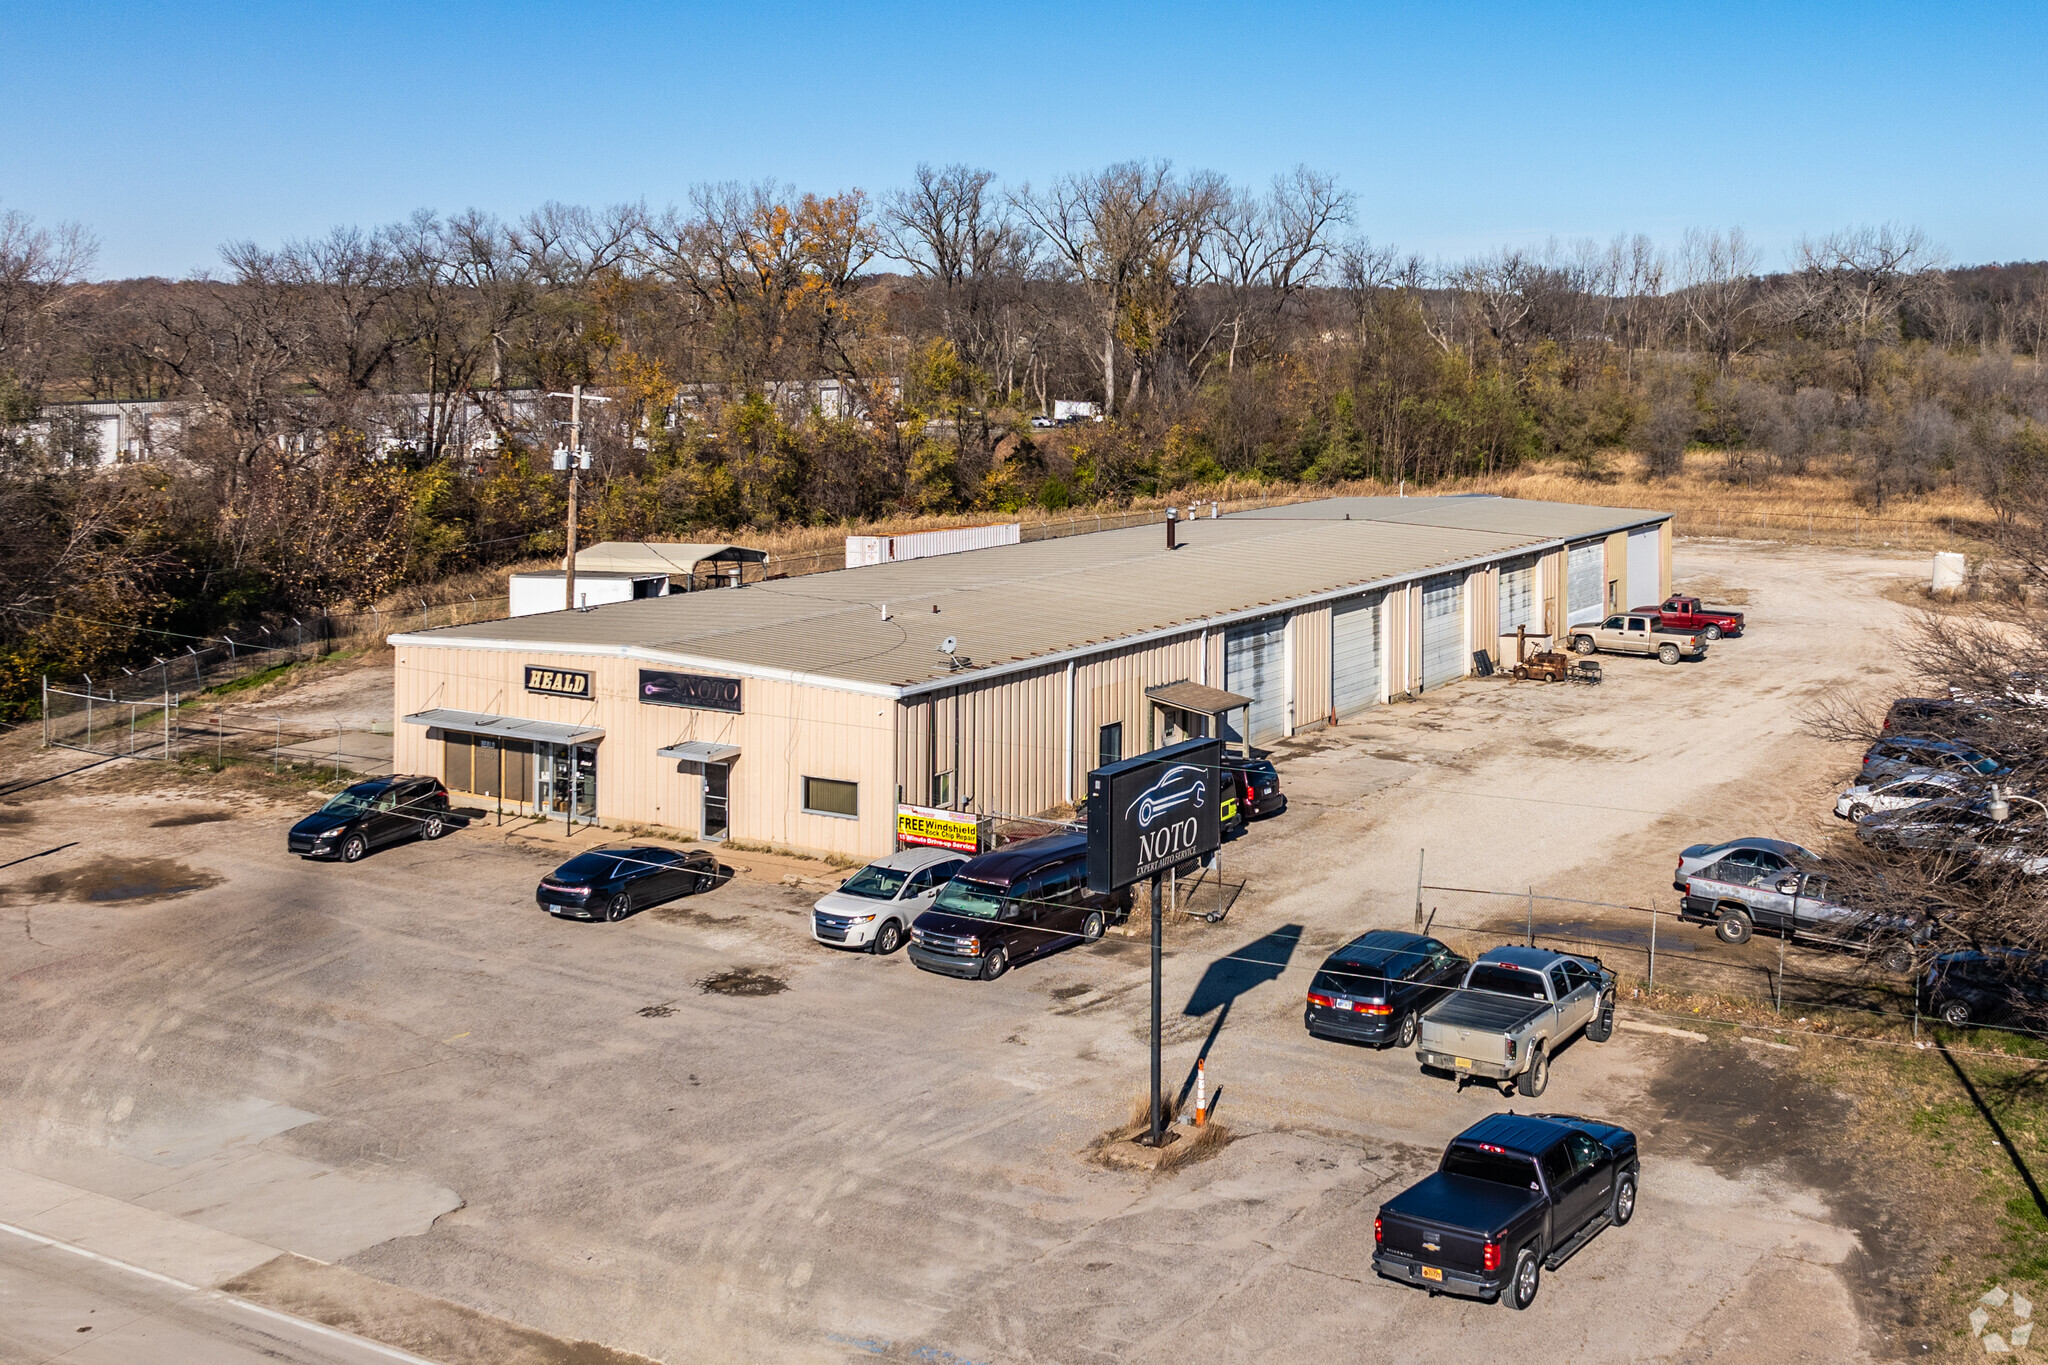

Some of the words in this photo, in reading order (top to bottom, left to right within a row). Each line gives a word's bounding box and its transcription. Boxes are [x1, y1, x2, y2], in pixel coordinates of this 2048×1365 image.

[529, 670, 586, 694] HEALD
[682, 677, 739, 702] NOTO
[899, 817, 924, 832] FREE
[925, 820, 975, 834] Windshield
[925, 828, 939, 836] Rock
[941, 831, 954, 839] Chip
[956, 833, 975, 841] Repair
[906, 835, 926, 843] Minute
[926, 838, 951, 847] Drive-up
[952, 840, 975, 850] Service
[1137, 817, 1198, 866] NOTO
[1136, 861, 1159, 876] EXPERT
[1159, 855, 1175, 868] AUTO
[1174, 845, 1197, 861] SERVICE
